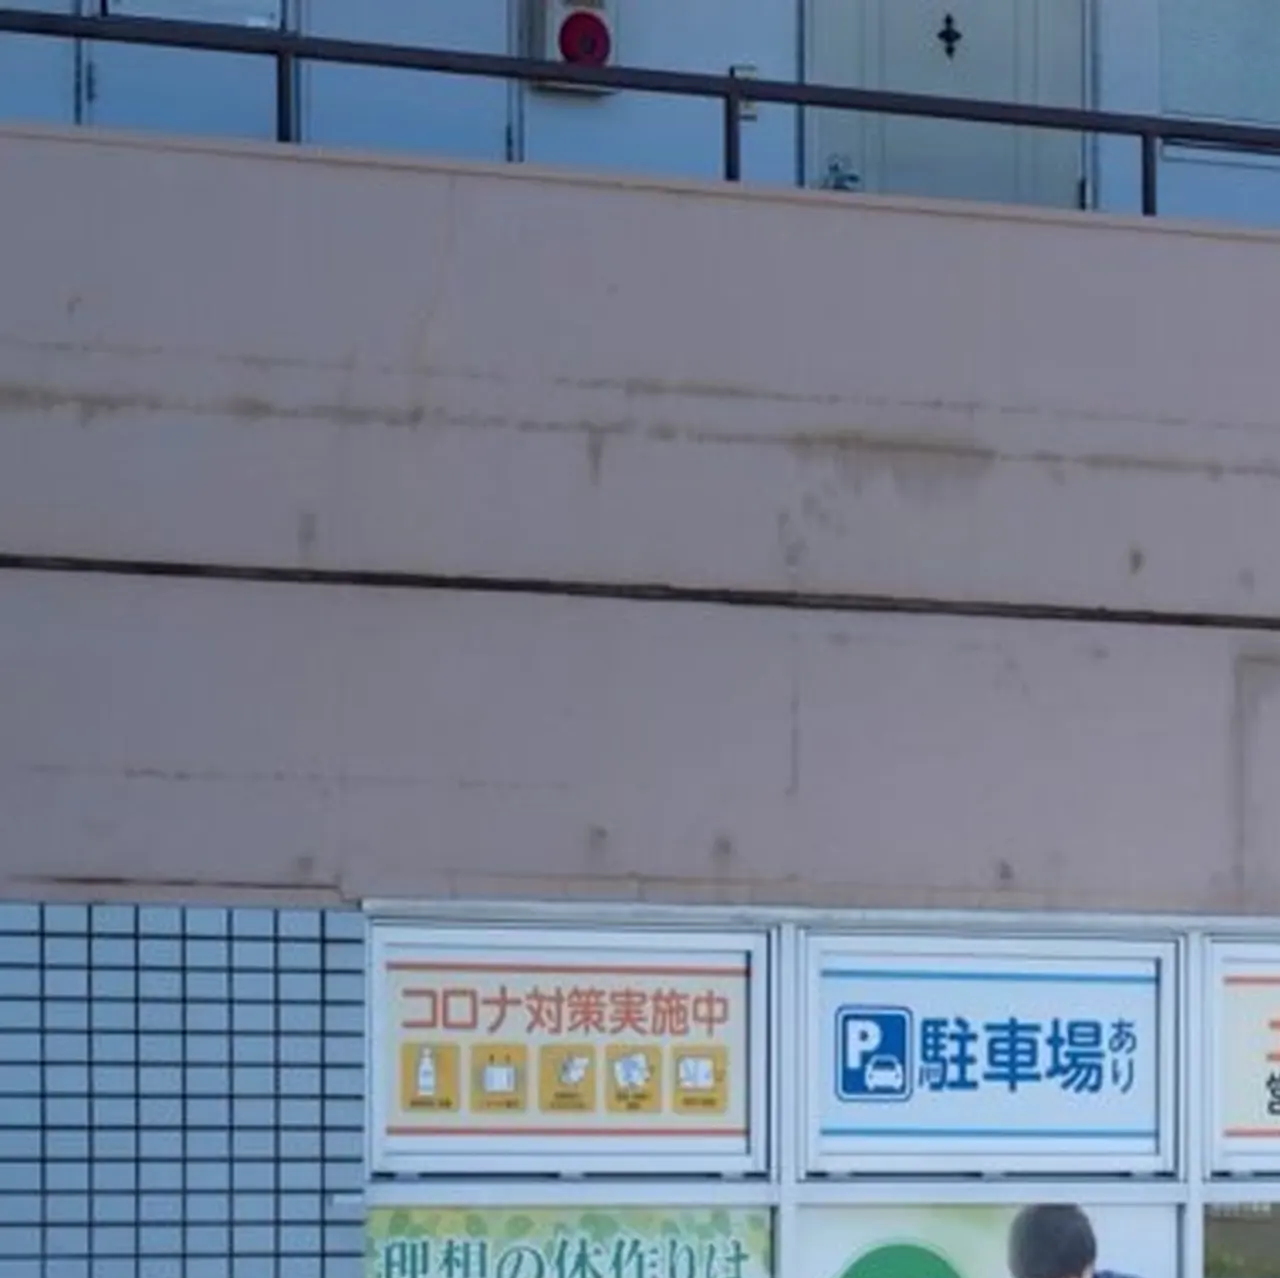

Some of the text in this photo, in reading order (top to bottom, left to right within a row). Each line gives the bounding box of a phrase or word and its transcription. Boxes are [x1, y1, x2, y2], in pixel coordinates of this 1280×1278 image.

[401, 986, 730, 1038] コロナ対策実施中
[918, 1018, 1105, 1094] 駐車場
[1107, 1018, 1139, 1093] あり
